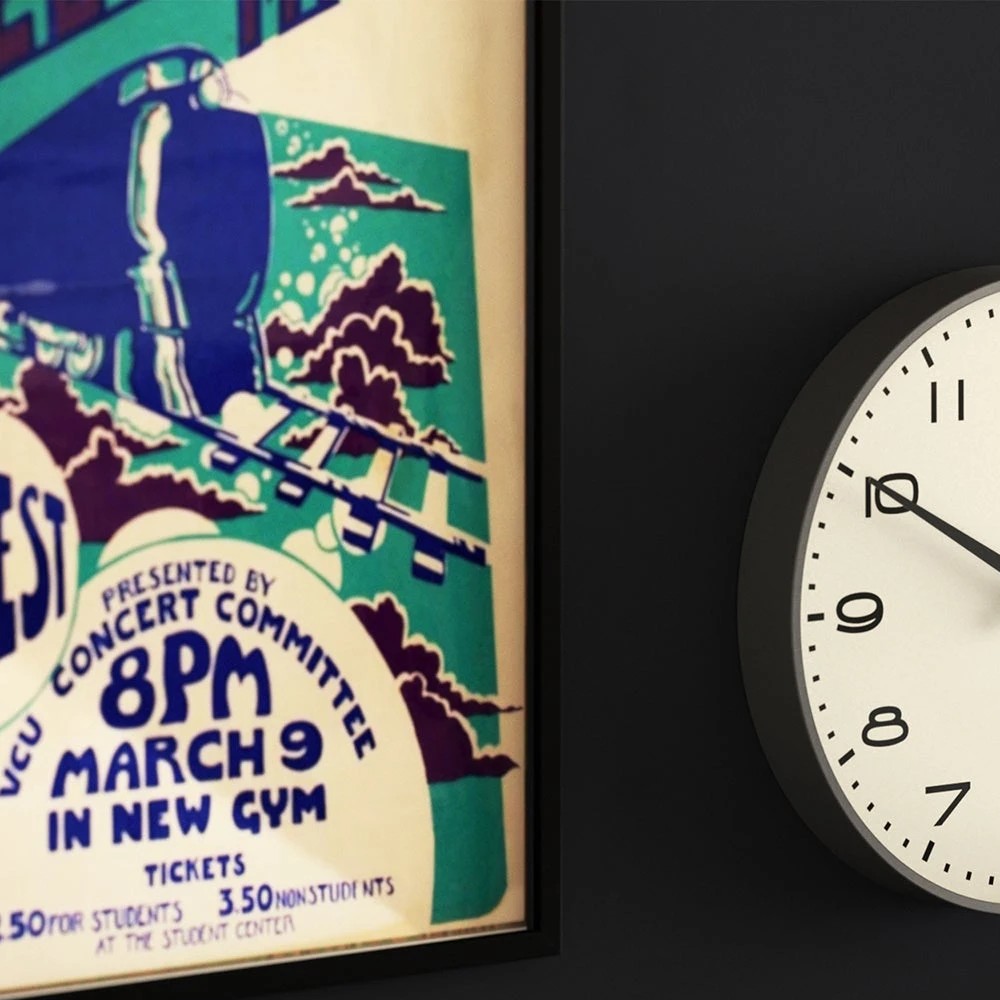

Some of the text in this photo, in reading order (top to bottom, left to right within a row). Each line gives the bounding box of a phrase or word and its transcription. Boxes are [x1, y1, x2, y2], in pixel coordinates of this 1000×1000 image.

[930, 379, 965, 423] 11
[865, 473, 919, 518] 10
[102, 560, 275, 611] PRESENTED BY
[836, 592, 884, 633] 9
[0, 588, 377, 796] VCU CONCERT COMMITTEE
[861, 705, 909, 748] 8
[51, 720, 323, 799] MARCH 9
[48, 783, 327, 852] IN NEW GYM
[925, 782, 971, 827] 7
[144, 853, 246, 887] TICKETS
[92, 900, 184, 933] STUDENTS
[126, 930, 153, 952] THE
